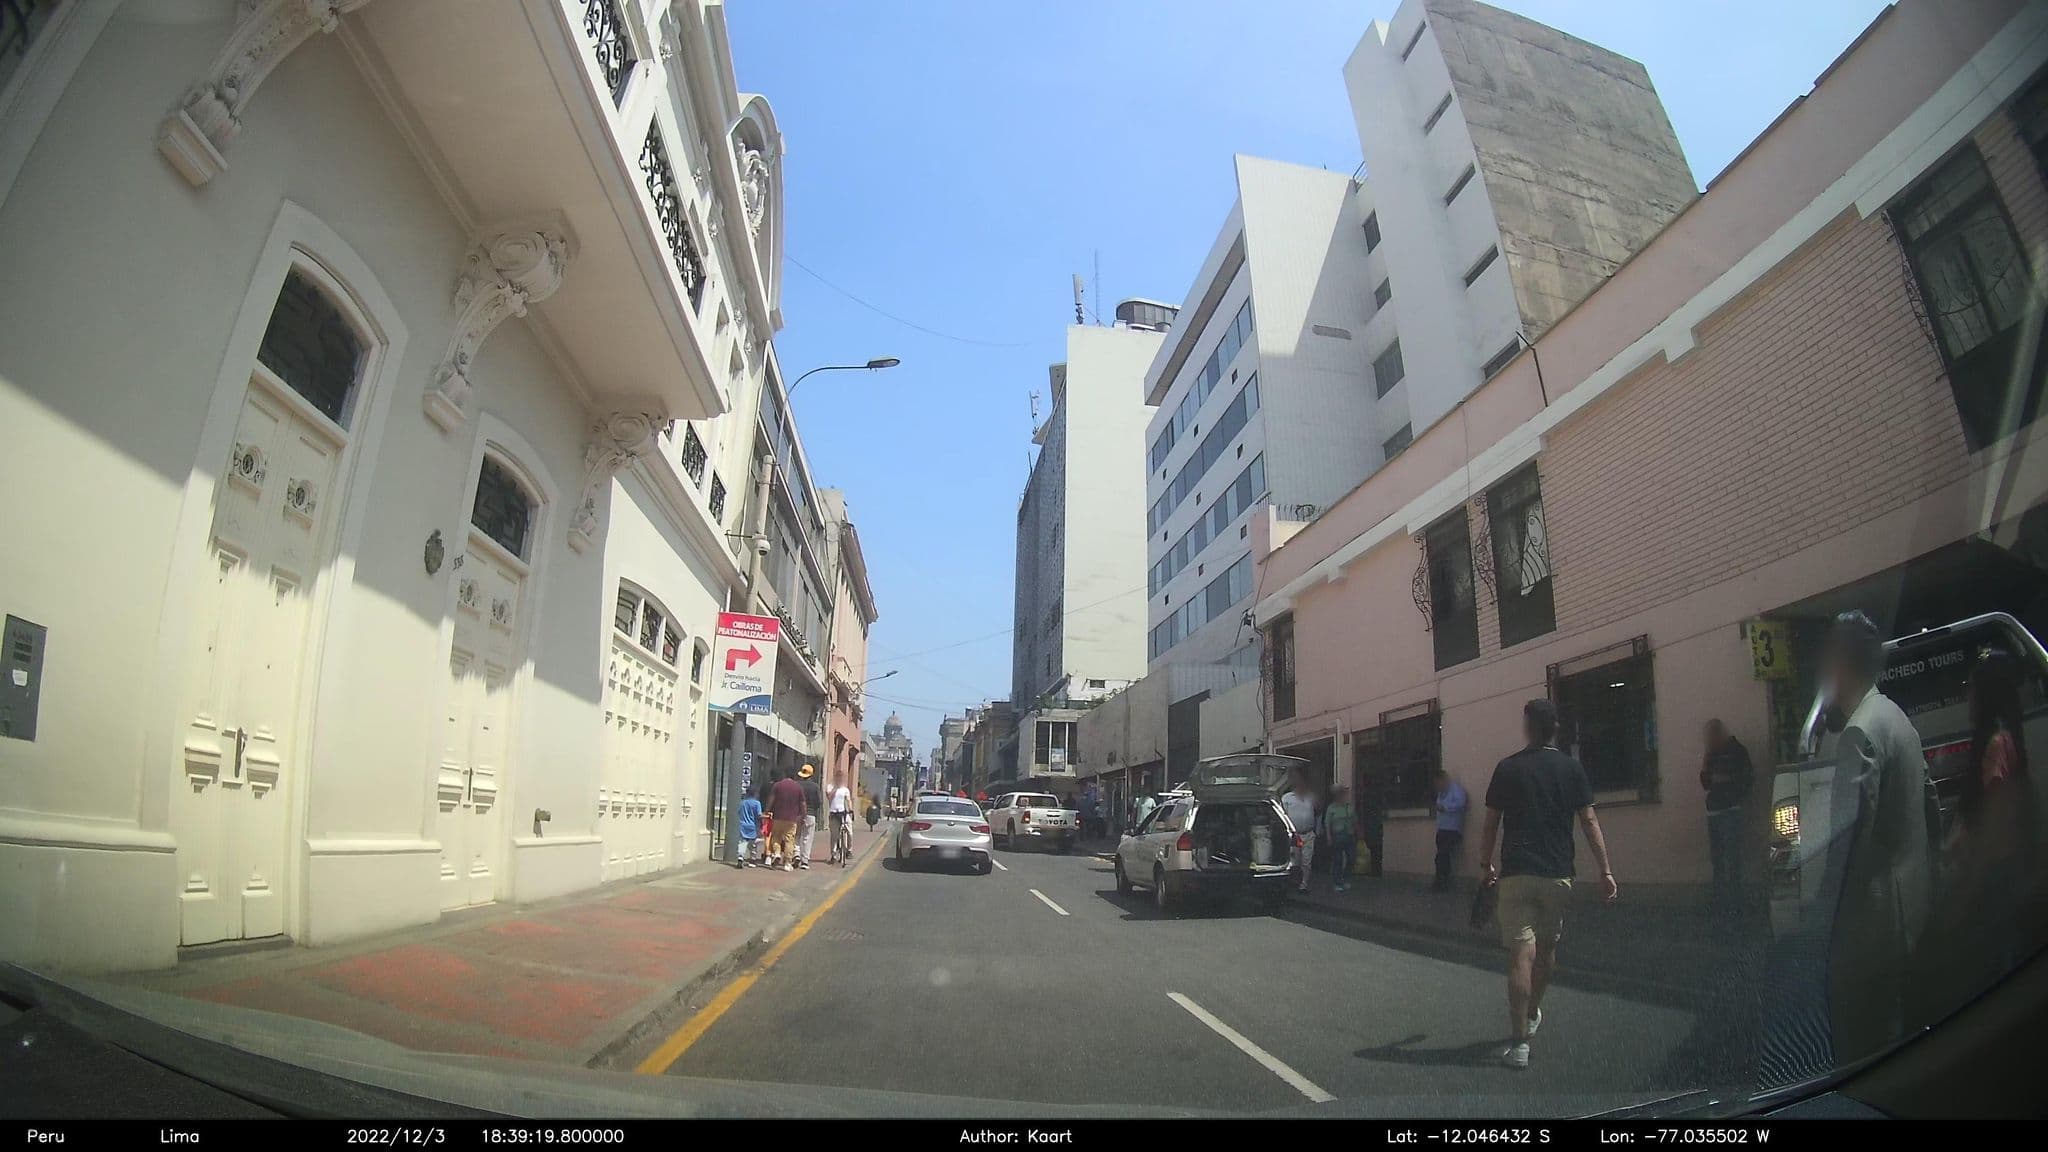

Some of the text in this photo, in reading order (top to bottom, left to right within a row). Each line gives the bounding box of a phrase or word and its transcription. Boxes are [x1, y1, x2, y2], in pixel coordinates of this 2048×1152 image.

[732, 621, 764, 632] OBRAS DE
[1759, 630, 1775, 667] 3
[1927, 650, 1965, 670] TOURS
[729, 681, 762, 693] Cailloma
[750, 705, 769, 713] LIMA
[1038, 818, 1068, 826] TOYOTA
